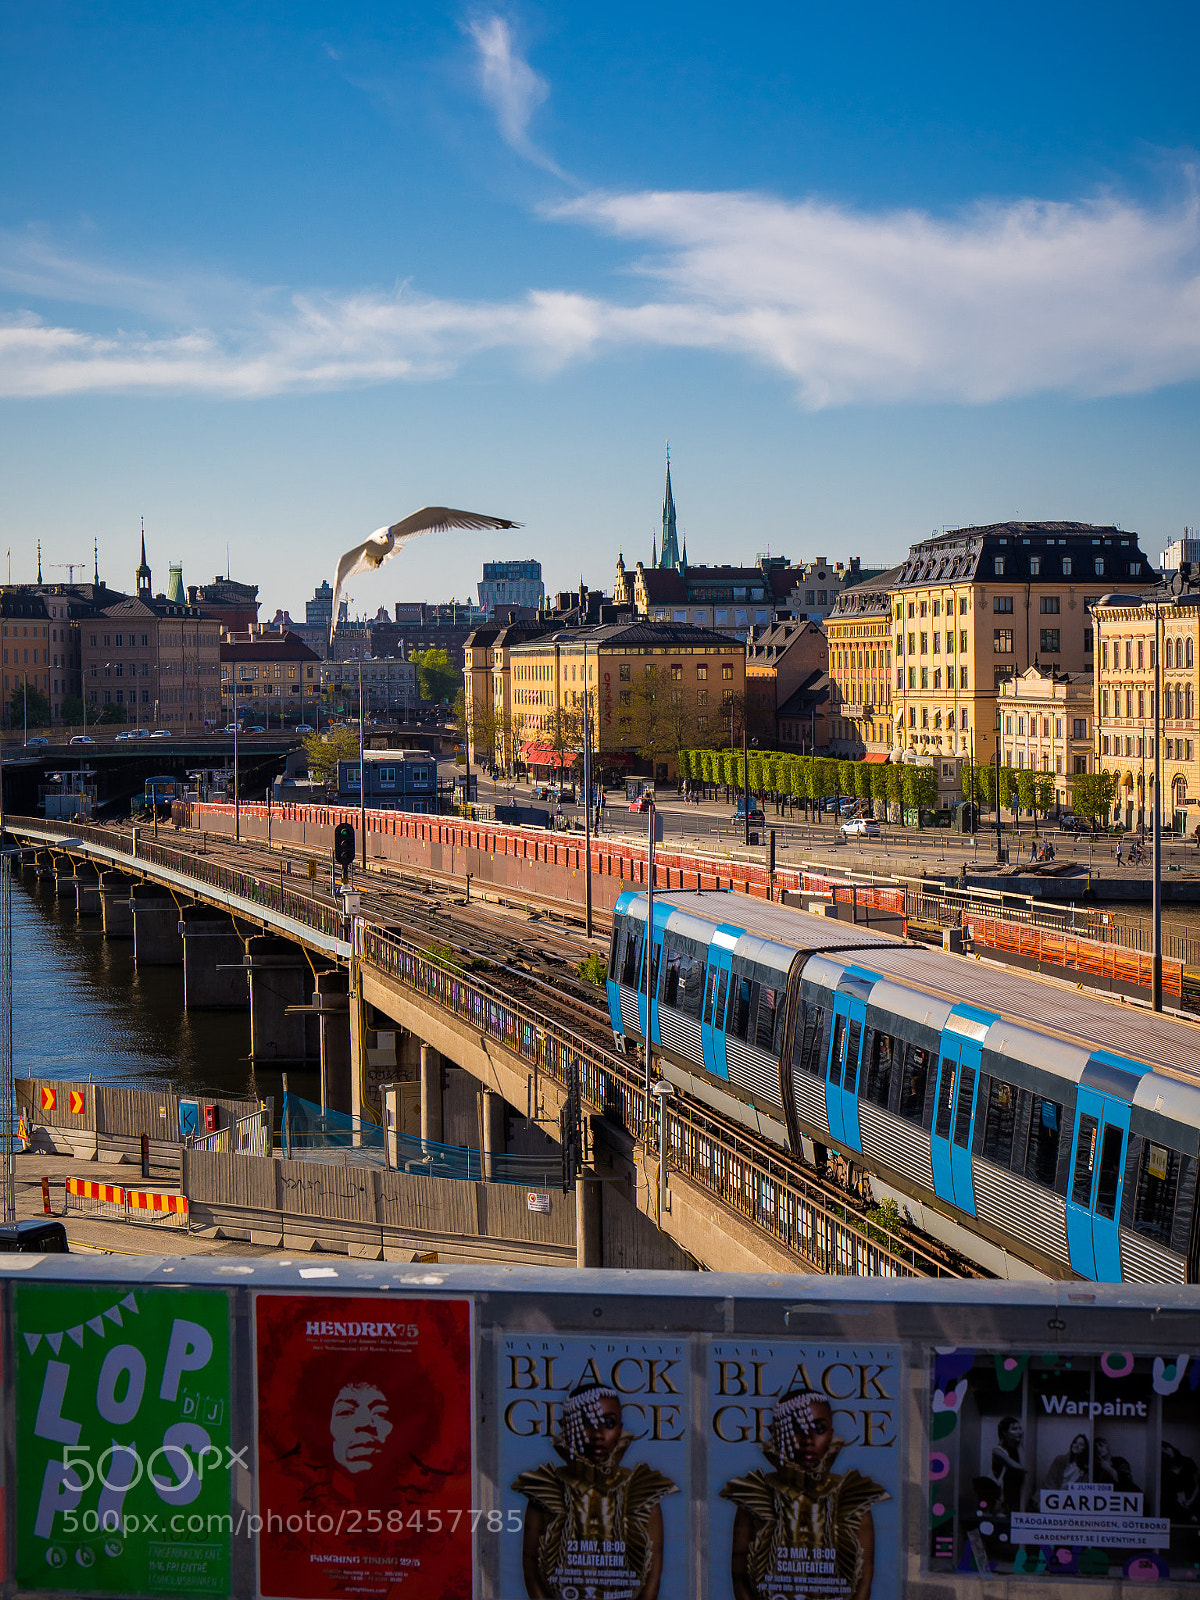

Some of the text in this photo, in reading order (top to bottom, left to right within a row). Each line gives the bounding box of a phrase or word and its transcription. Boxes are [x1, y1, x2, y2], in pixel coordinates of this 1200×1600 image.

[183, 1110, 194, 1130] K
[506, 1341, 682, 1354] MARY NDIAYE
[714, 1347, 895, 1360] MARY NDIAYE
[506, 1355, 683, 1394] BLACK
[714, 1360, 895, 1400] BLACK
[1041, 1394, 1147, 1420] Warpaint
[504, 1399, 686, 1441] GCE
[712, 1405, 897, 1447] GCE
[1045, 1494, 1138, 1512] GARDEN
[1014, 1516, 1167, 1530] TRÄDGÅRDSFÖRENINGEN, GÖTEBORG
[1033, 1534, 1147, 1544] GARDENFEST.SE EVENTIM.SE
[567, 1540, 625, 1553] 23 MAY, 18:00
[777, 1547, 836, 1560] 23 MAY, 18:00
[166, 1561, 179, 1572] FRI
[310, 1554, 420, 1567] FASCHING TISDAG 22/5
[567, 1554, 624, 1567] SCALATEATERN
[777, 1560, 834, 1574] SCALATEATERN
